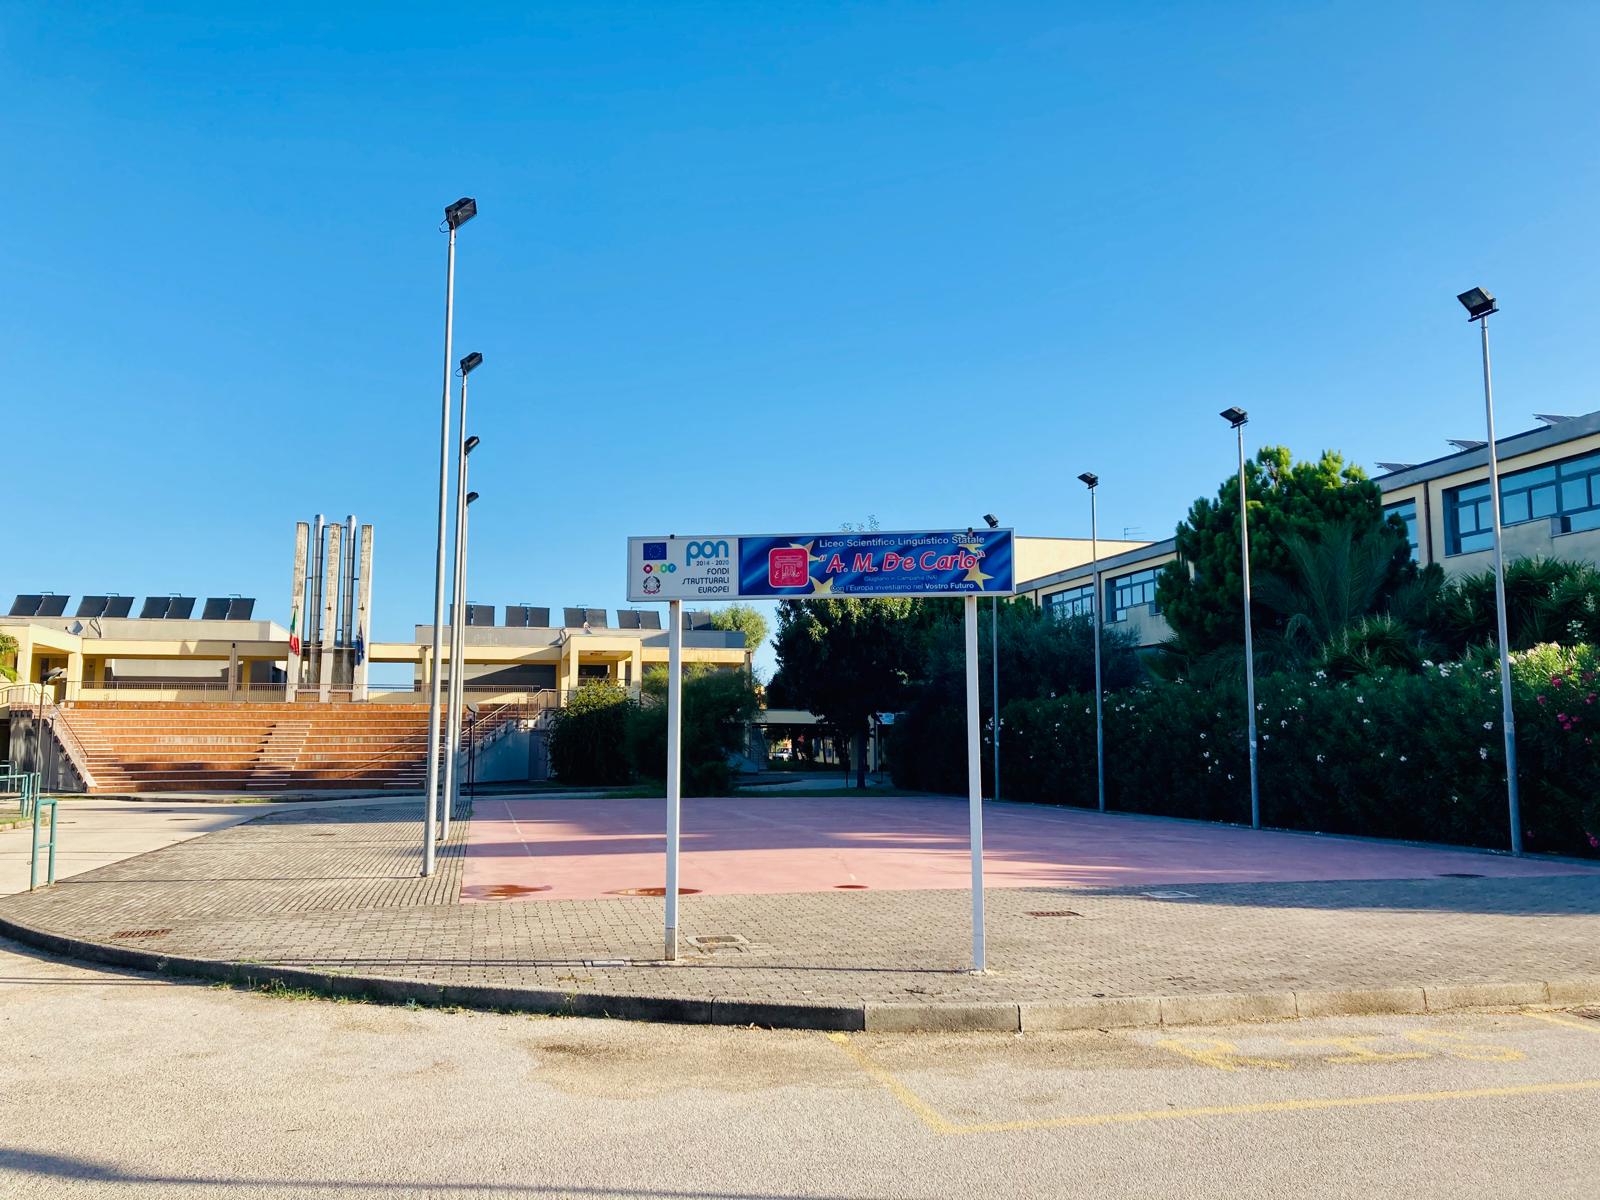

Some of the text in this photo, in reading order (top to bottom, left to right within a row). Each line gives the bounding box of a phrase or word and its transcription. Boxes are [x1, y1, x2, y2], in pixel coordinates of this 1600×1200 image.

[819, 535, 985, 548] Liceo Scientifico Linguistico Statale
[686, 540, 729, 566] pon
[852, 552, 879, 573] M.
[882, 552, 916, 571] De
[706, 567, 729, 575] FONDI
[682, 576, 729, 585] STRUTTURALI
[697, 585, 729, 594] EUROPEI
